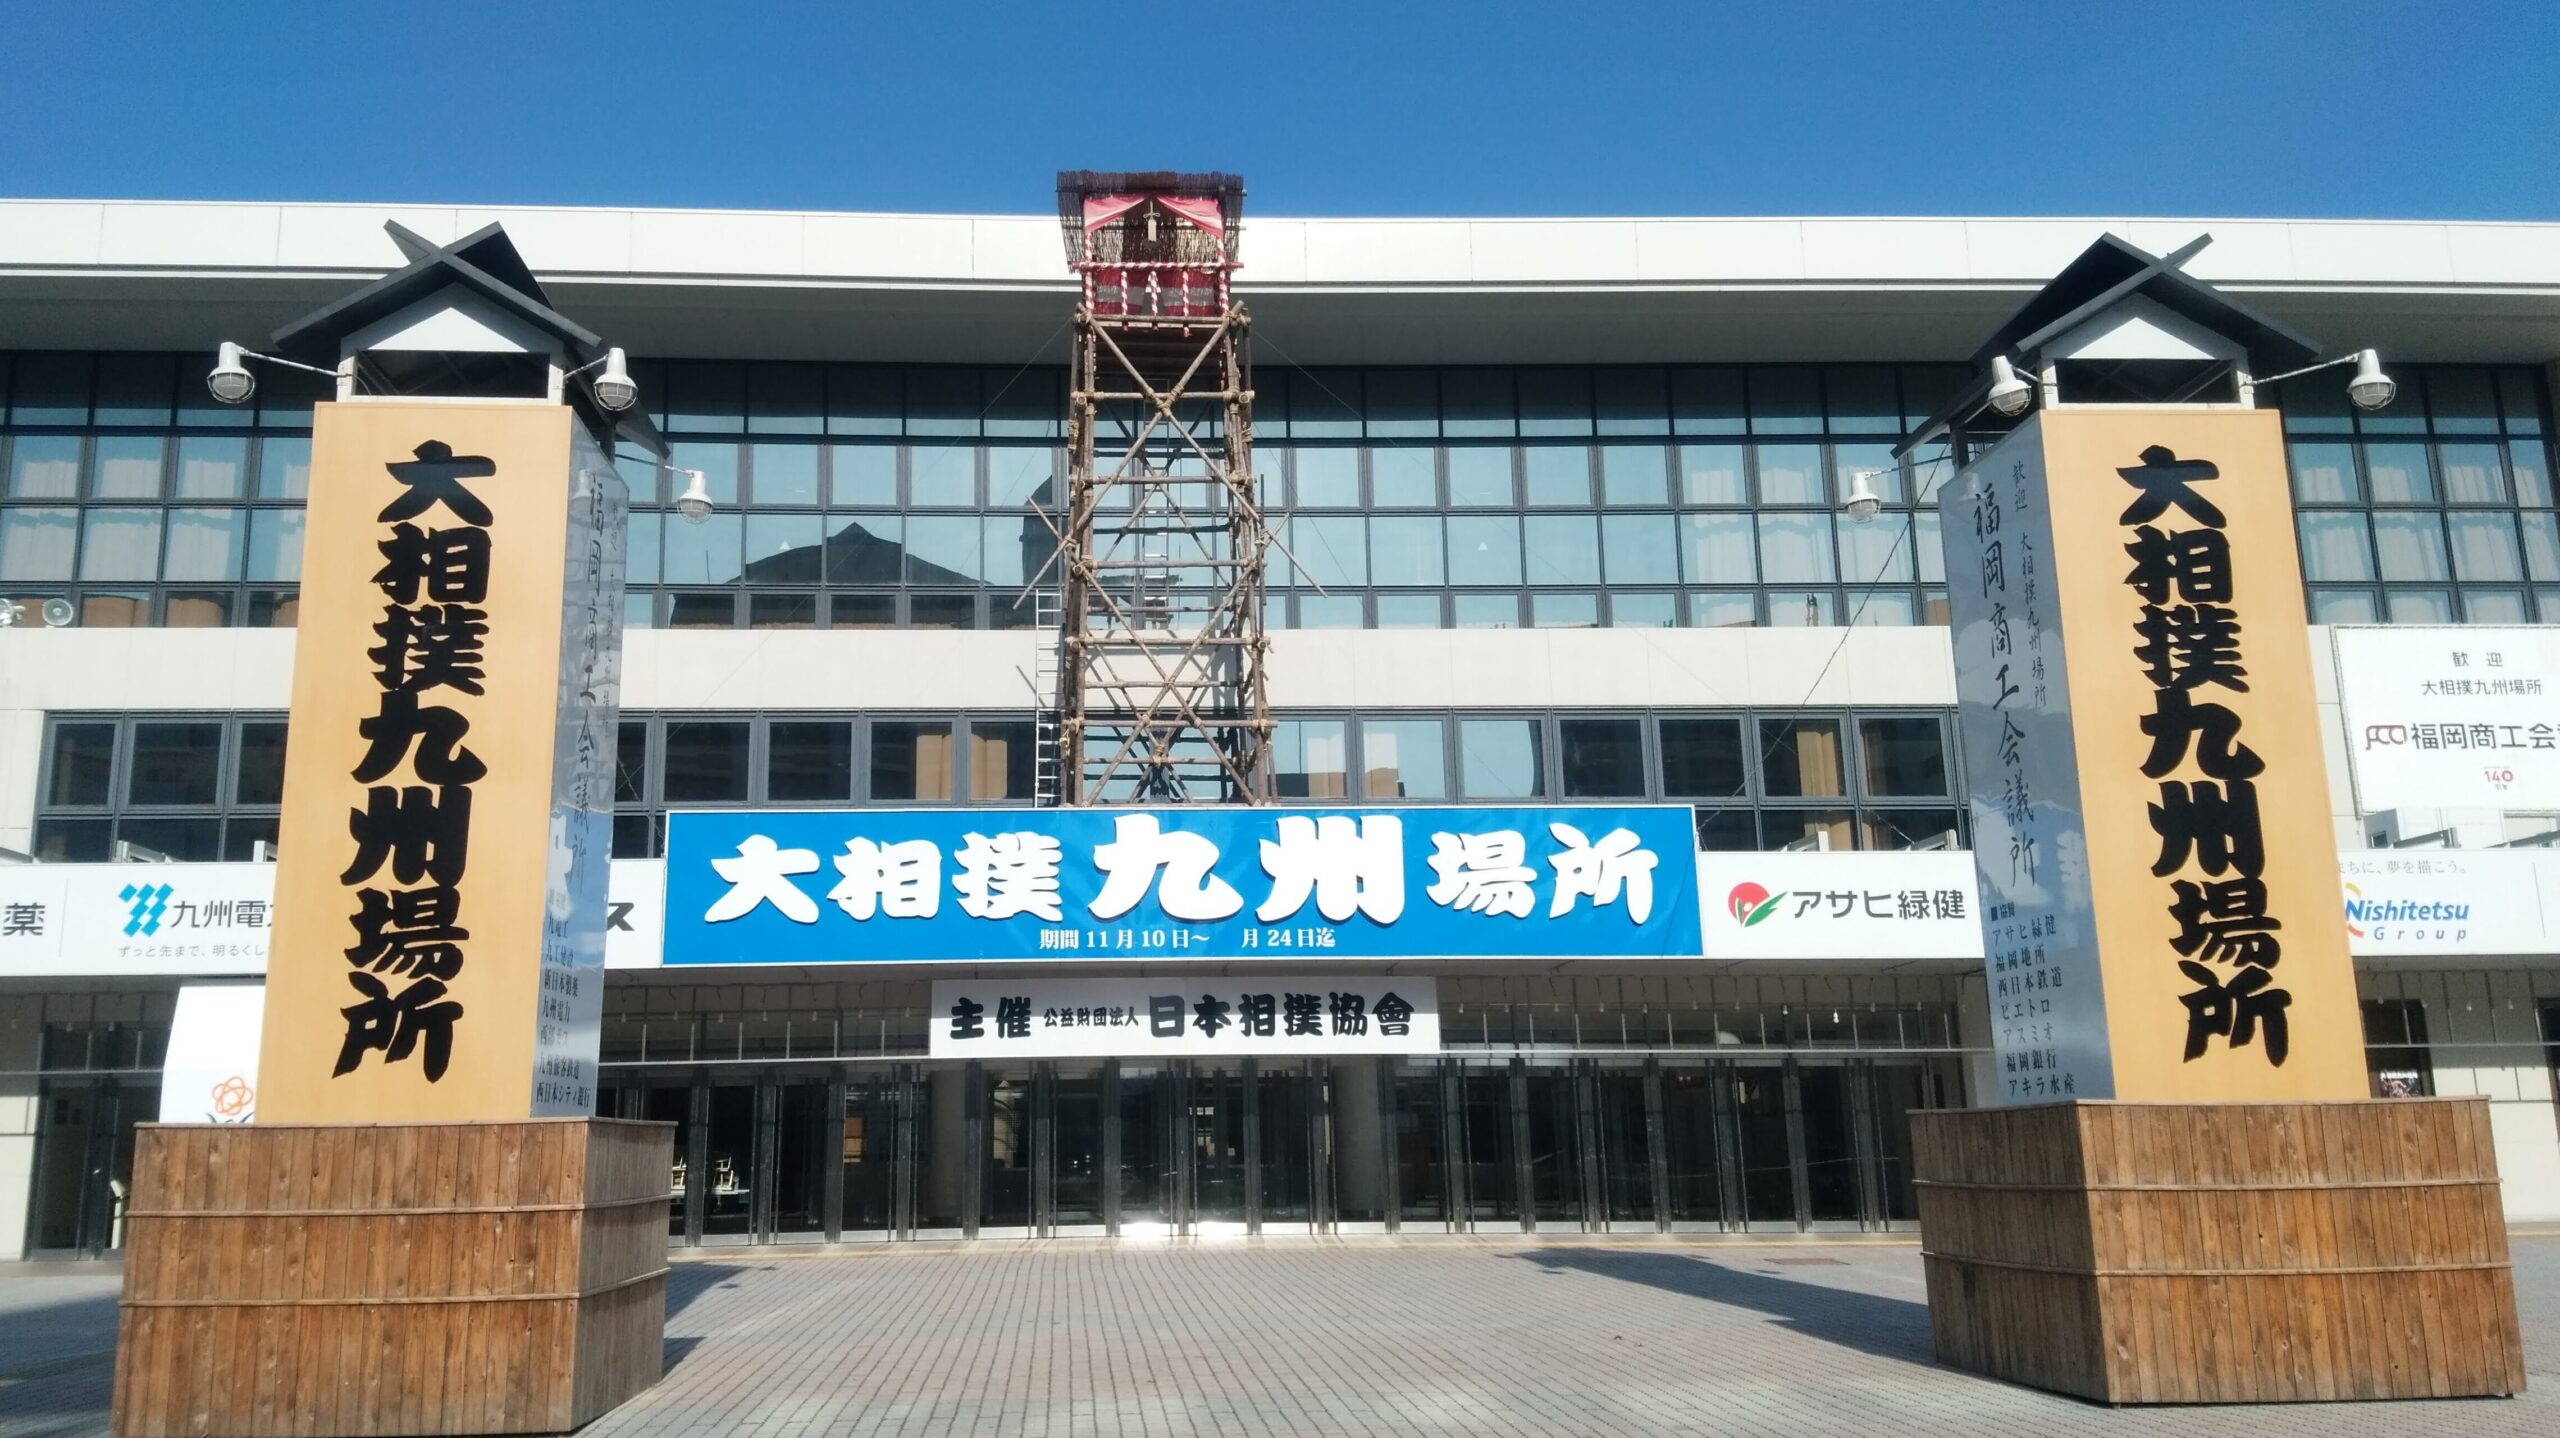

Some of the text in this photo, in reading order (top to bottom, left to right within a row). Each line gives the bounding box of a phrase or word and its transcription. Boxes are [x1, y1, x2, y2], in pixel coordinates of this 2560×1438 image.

[2019, 531, 2047, 708] 大相撲九州場所
[2452, 651, 2503, 667] 歓迎
[1973, 482, 2035, 888] 福岡商工会議所
[2421, 679, 2542, 696] 大相撲九州場所
[2411, 722, 2560, 750] 福岡商工会
[332, 439, 497, 1083] 大相撲九州場所
[2115, 444, 2292, 1068] 大相撲九州場所
[704, 814, 1659, 927] 大相撲九州場所
[2, 902, 46, 937] 薬
[170, 900, 273, 929] 九州電
[1792, 890, 1966, 919] アサヒ緑健
[2345, 900, 2470, 922] Nishitetsu
[1993, 914, 2057, 946] アサヒ緑健
[2373, 926, 2467, 942] Group
[1995, 944, 2046, 974] 福岡地所
[1998, 967, 2063, 998] 西日本鉄道
[949, 991, 1415, 1040] 主催 公益財団法人 日本相撲協會
[2006, 1048, 2057, 1073] 福岡銀行
[2008, 1072, 2076, 1098] アキラ水産
